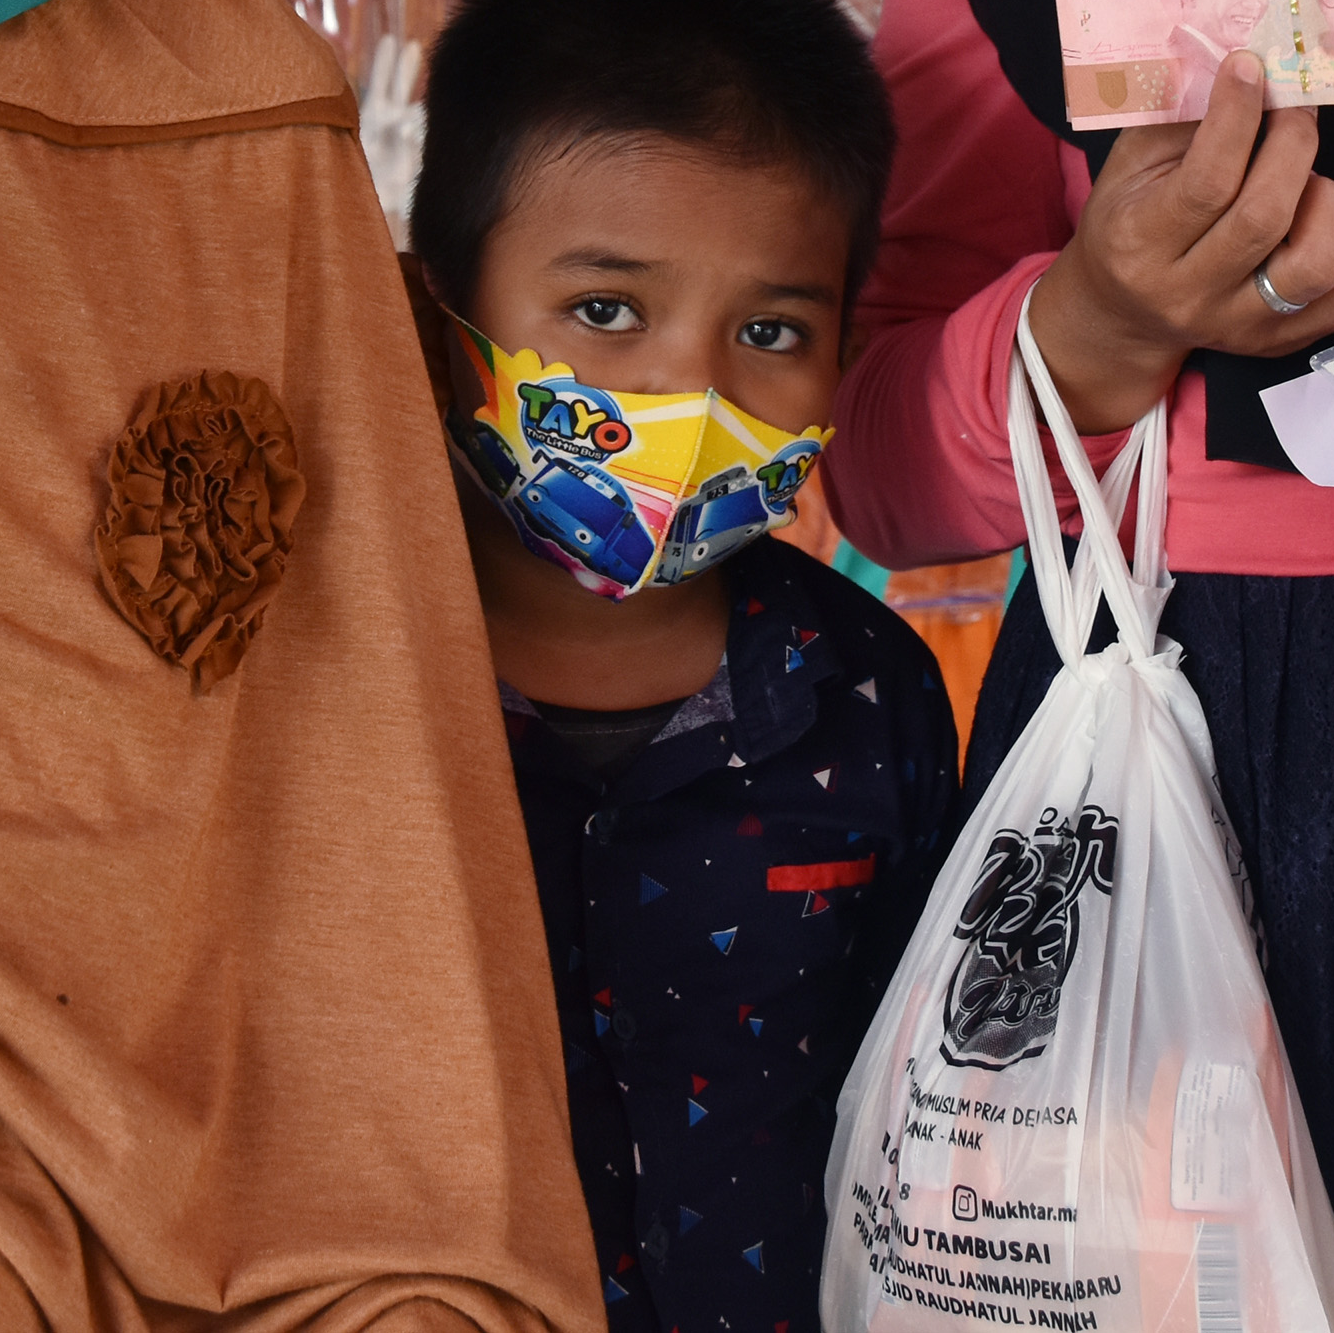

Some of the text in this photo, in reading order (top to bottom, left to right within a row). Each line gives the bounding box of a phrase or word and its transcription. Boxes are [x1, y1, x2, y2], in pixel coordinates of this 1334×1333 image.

[518, 382, 632, 454] TAYO
[526, 427, 547, 442] The
[546, 436, 579, 454] Little
[756, 453, 818, 494] TAY
[671, 547, 682, 557] 75
[974, 1100, 1006, 1122] PRIA
[1012, 1106, 1078, 1127] DEASA
[947, 1127, 984, 1151] ANAK
[923, 1228, 1051, 1265] TAMBUSAI
[888, 1249, 956, 1287] AUDHATUL
[916, 1289, 1025, 1325] RAUDHATUL
